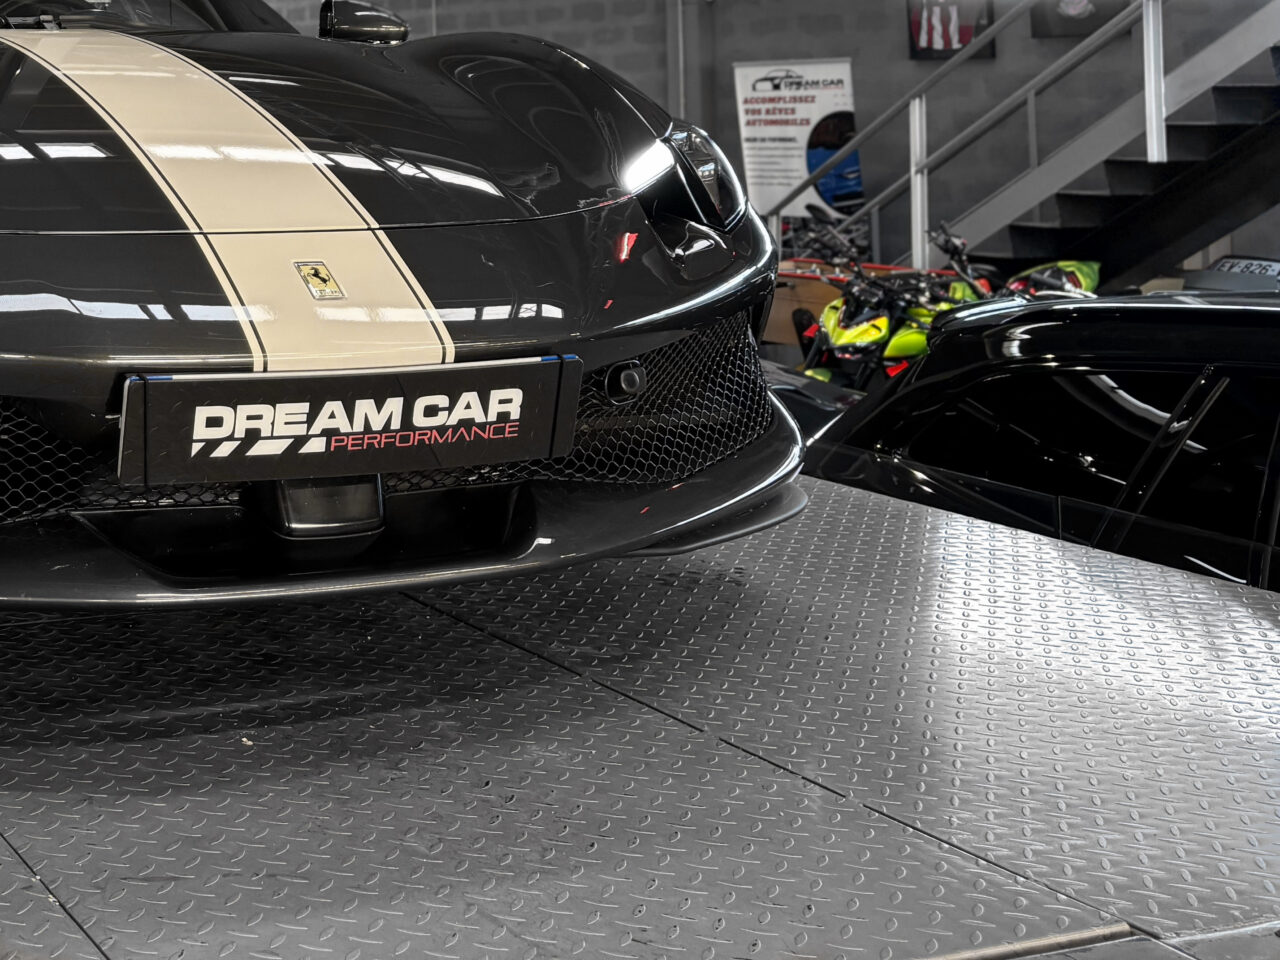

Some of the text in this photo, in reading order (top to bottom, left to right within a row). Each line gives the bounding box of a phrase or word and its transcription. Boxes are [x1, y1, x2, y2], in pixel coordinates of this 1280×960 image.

[822, 78, 844, 86] CAR
[743, 95, 816, 105] ACCOMPLISSEZ
[744, 108, 762, 116] VOS
[745, 118, 811, 127] AUTOMOBILES
[192, 388, 524, 440] DREAM CAR
[330, 422, 520, 451] PERFORMANCE
